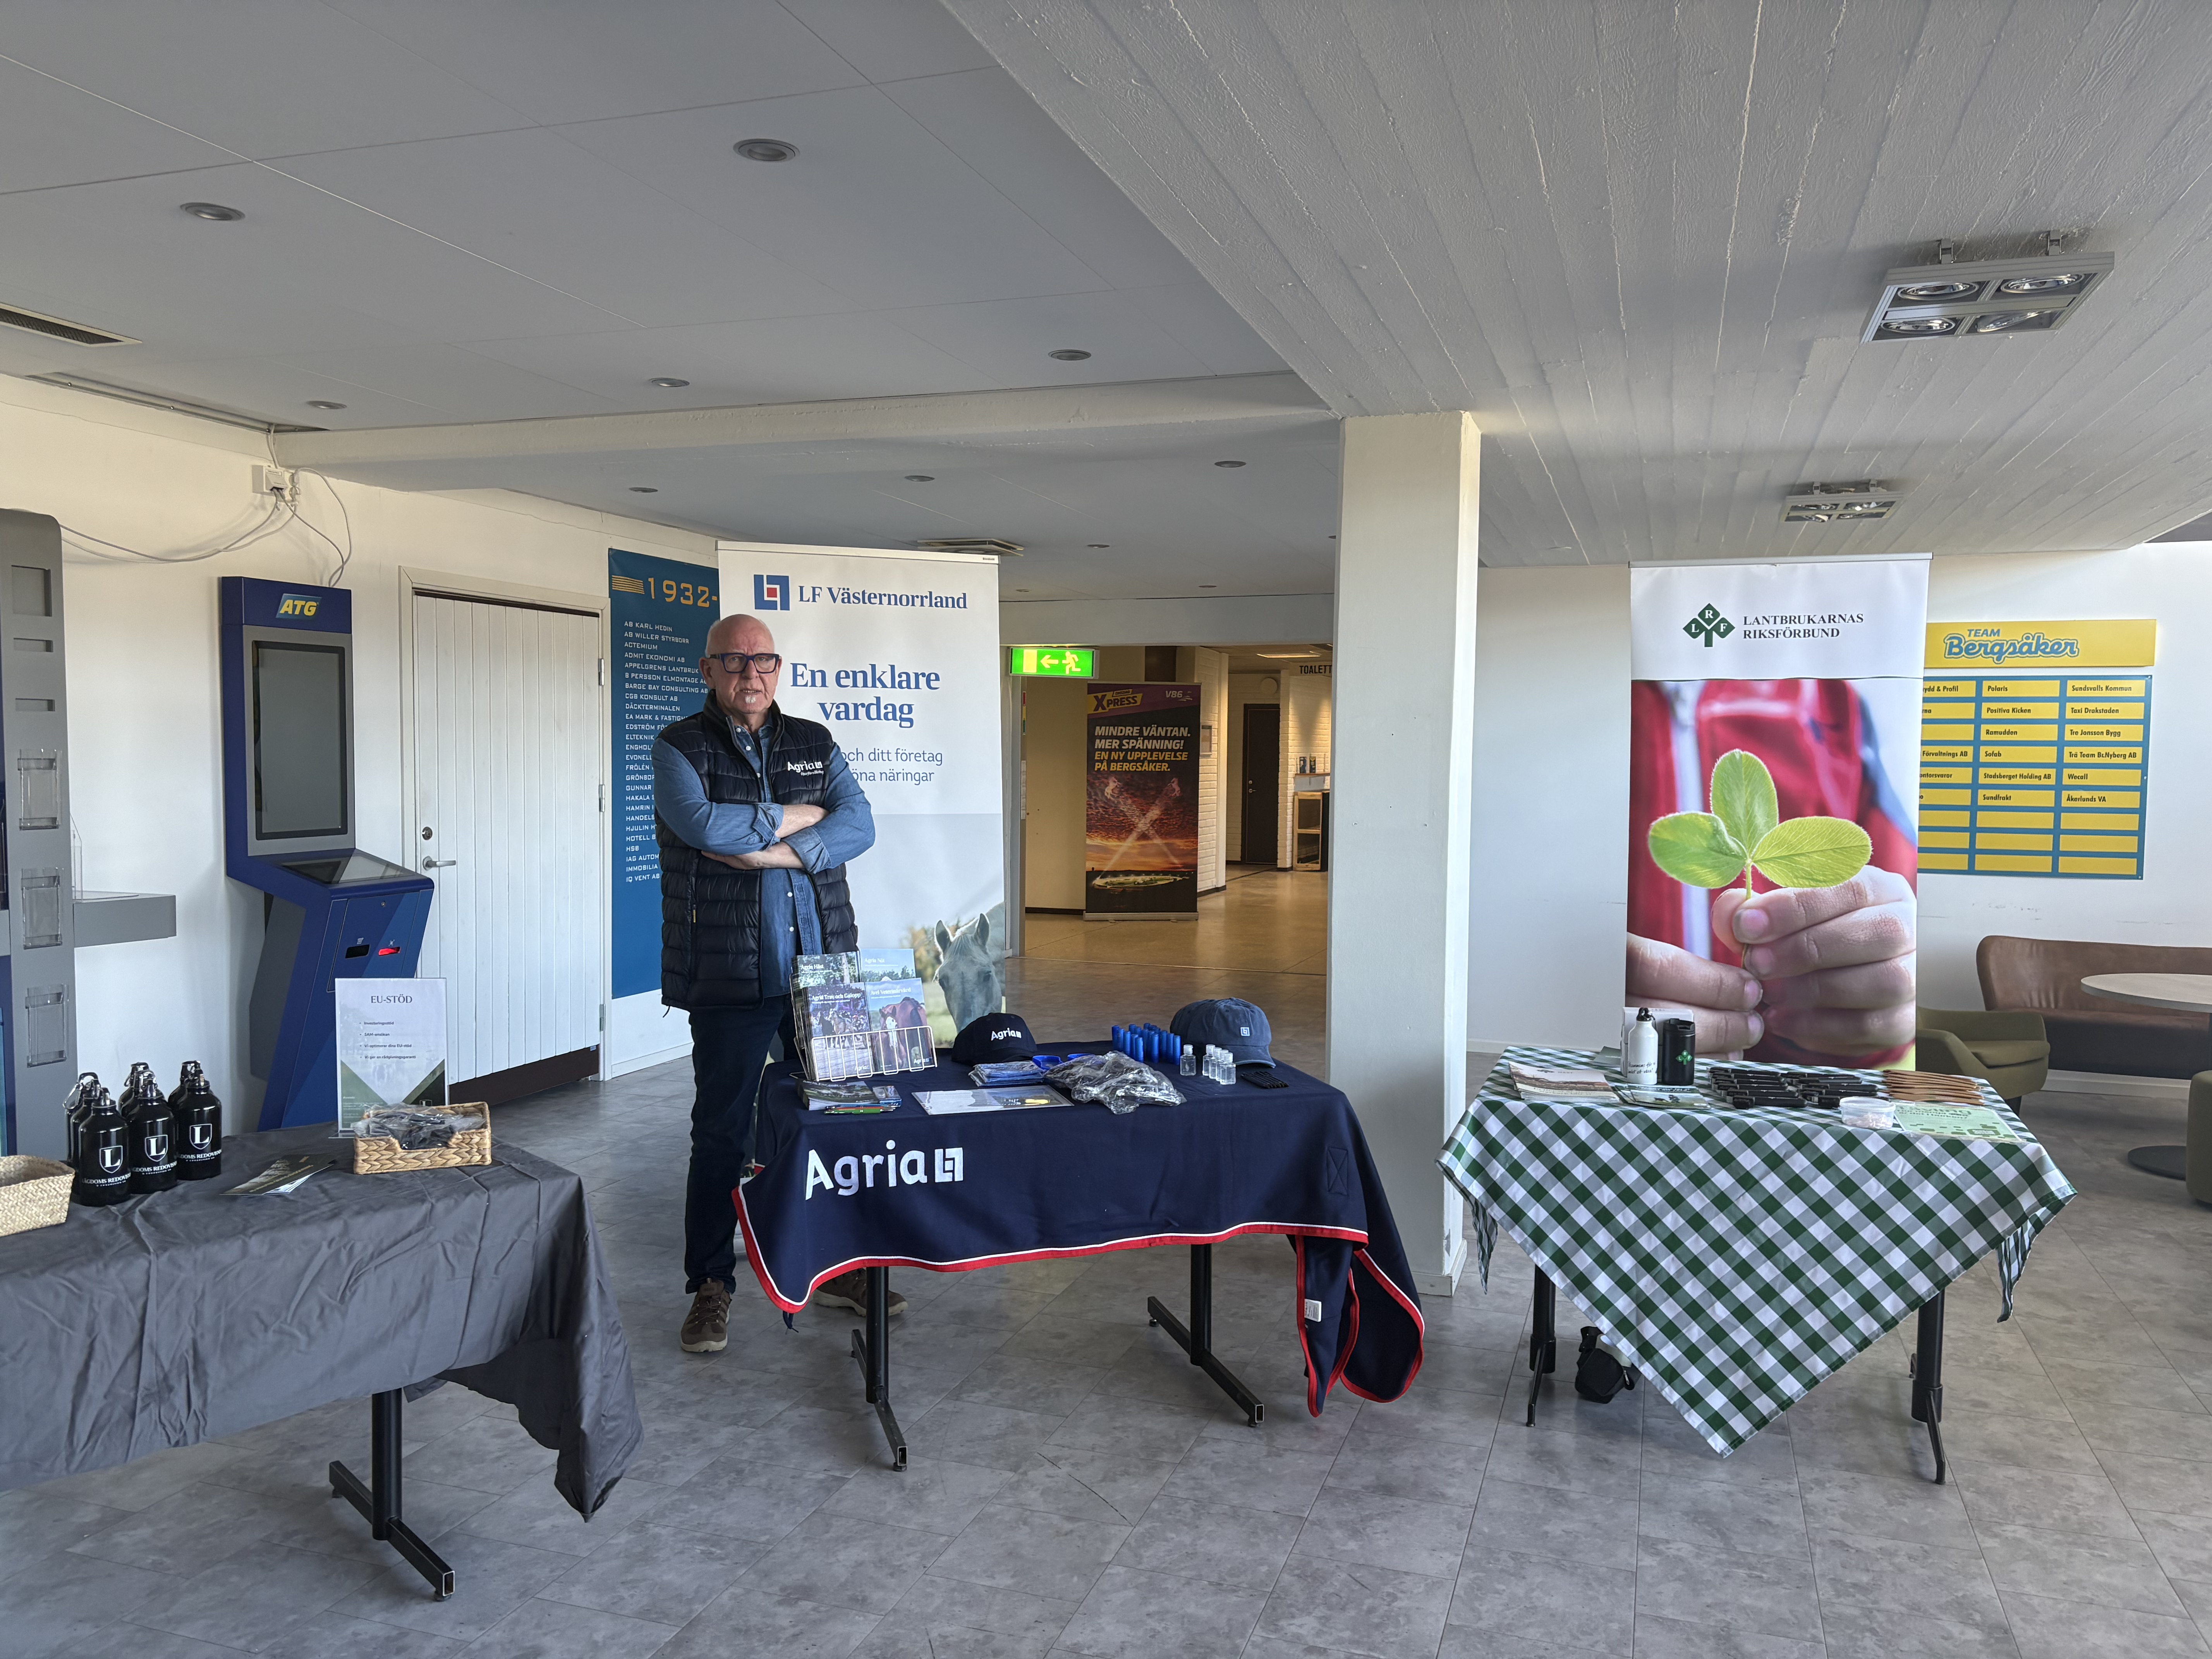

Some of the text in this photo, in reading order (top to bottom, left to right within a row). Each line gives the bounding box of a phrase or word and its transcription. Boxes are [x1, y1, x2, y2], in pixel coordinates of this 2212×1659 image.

[799, 586, 967, 608] LF Västernorrland
[279, 599, 317, 616] ATG
[1744, 614, 1863, 625] LANTBRUKARNAS
[1744, 627, 1839, 639] RIKSFÖRBUND
[1967, 629, 2001, 637] TEAM
[1943, 632, 2080, 665] Bergsåker
[790, 663, 940, 690] En enklare
[817, 697, 914, 728] vardag
[1095, 725, 1190, 736] MINDRE VÄNTAN.
[1095, 737, 1184, 749] MER SPÄNNING!
[869, 748, 892, 761] ditt
[895, 748, 942, 766] företag
[1111, 752, 1125, 760] NY
[1128, 752, 1188, 760] UPPLEVELSE
[788, 761, 816, 774] Agria
[1095, 760, 1170, 771] PÅ BERGSÅKER.
[879, 769, 934, 785] näringar
[371, 994, 412, 1003] EU-STÖD
[991, 1028, 1018, 1041] Agria
[193, 1127, 210, 1144] L
[149, 1138, 165, 1156] L
[104, 1149, 120, 1168] L
[805, 1140, 927, 1200] Agria
